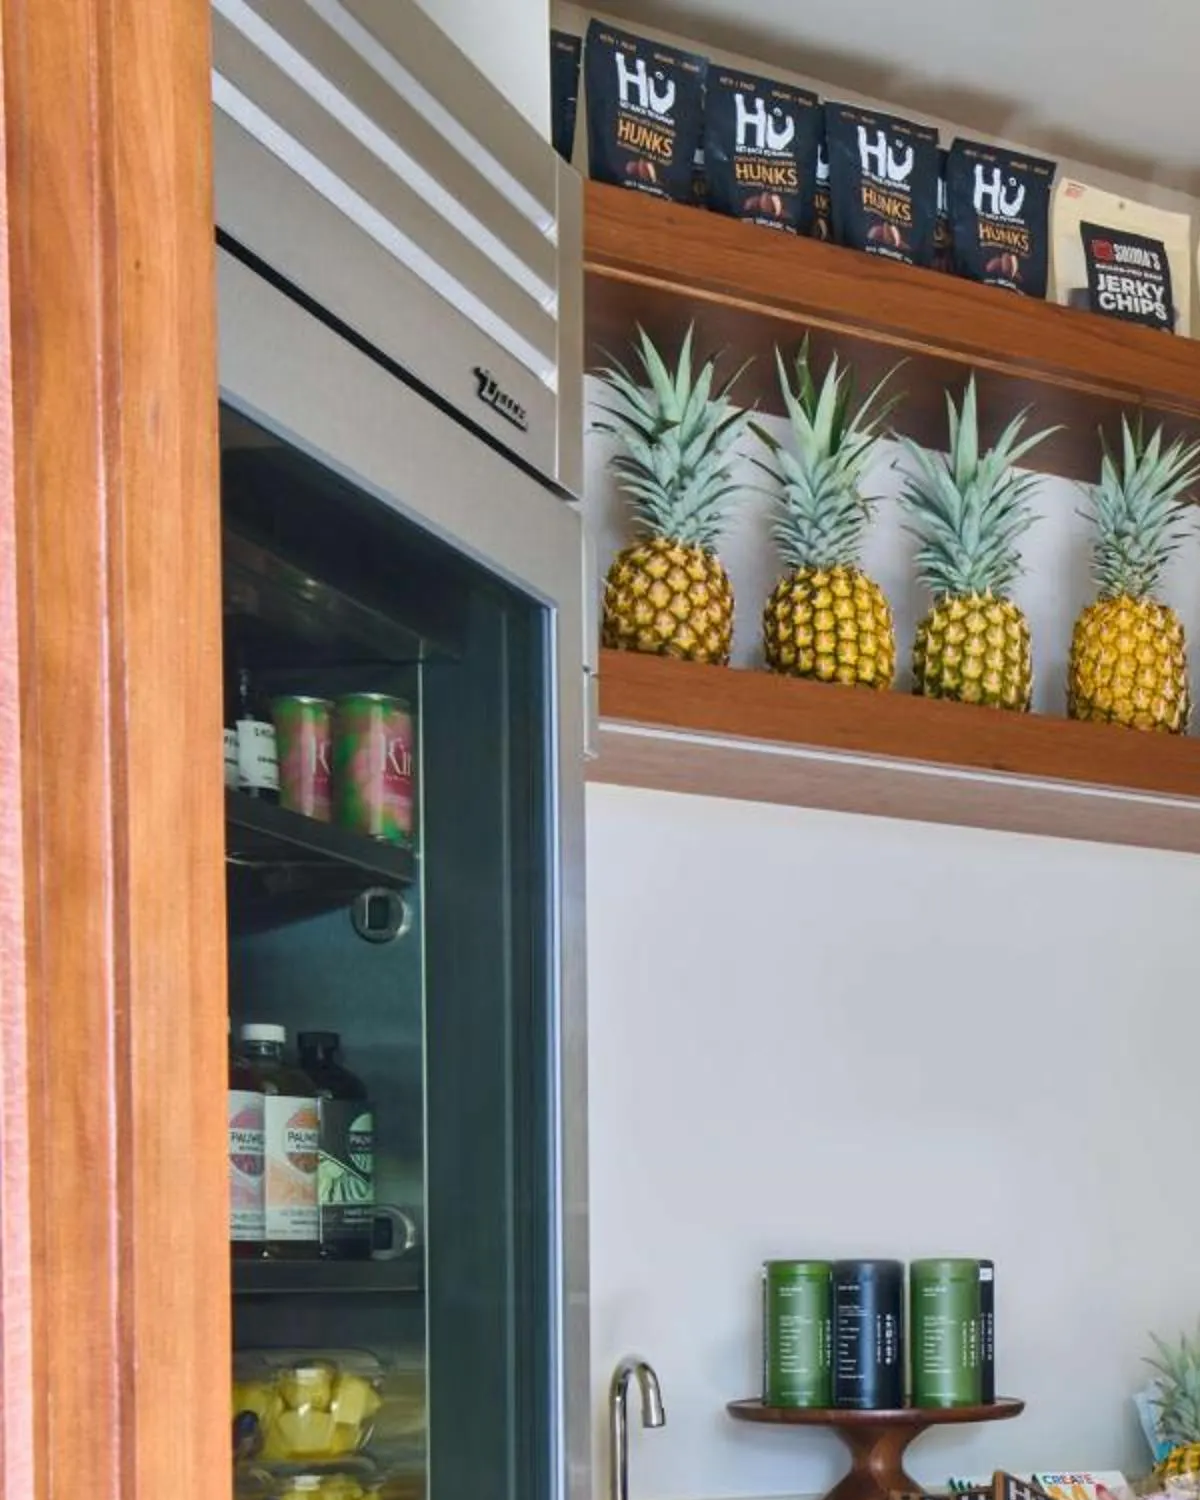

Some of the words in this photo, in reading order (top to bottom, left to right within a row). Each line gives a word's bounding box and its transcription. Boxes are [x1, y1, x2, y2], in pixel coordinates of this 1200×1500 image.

[617, 117, 674, 157] HUNKS
[735, 163, 798, 186] HUNKS
[861, 186, 912, 221] HUNKS
[978, 222, 1030, 252] HUNKS
[1097, 273, 1165, 300] JERKY
[1098, 292, 1168, 321] CHIPS
